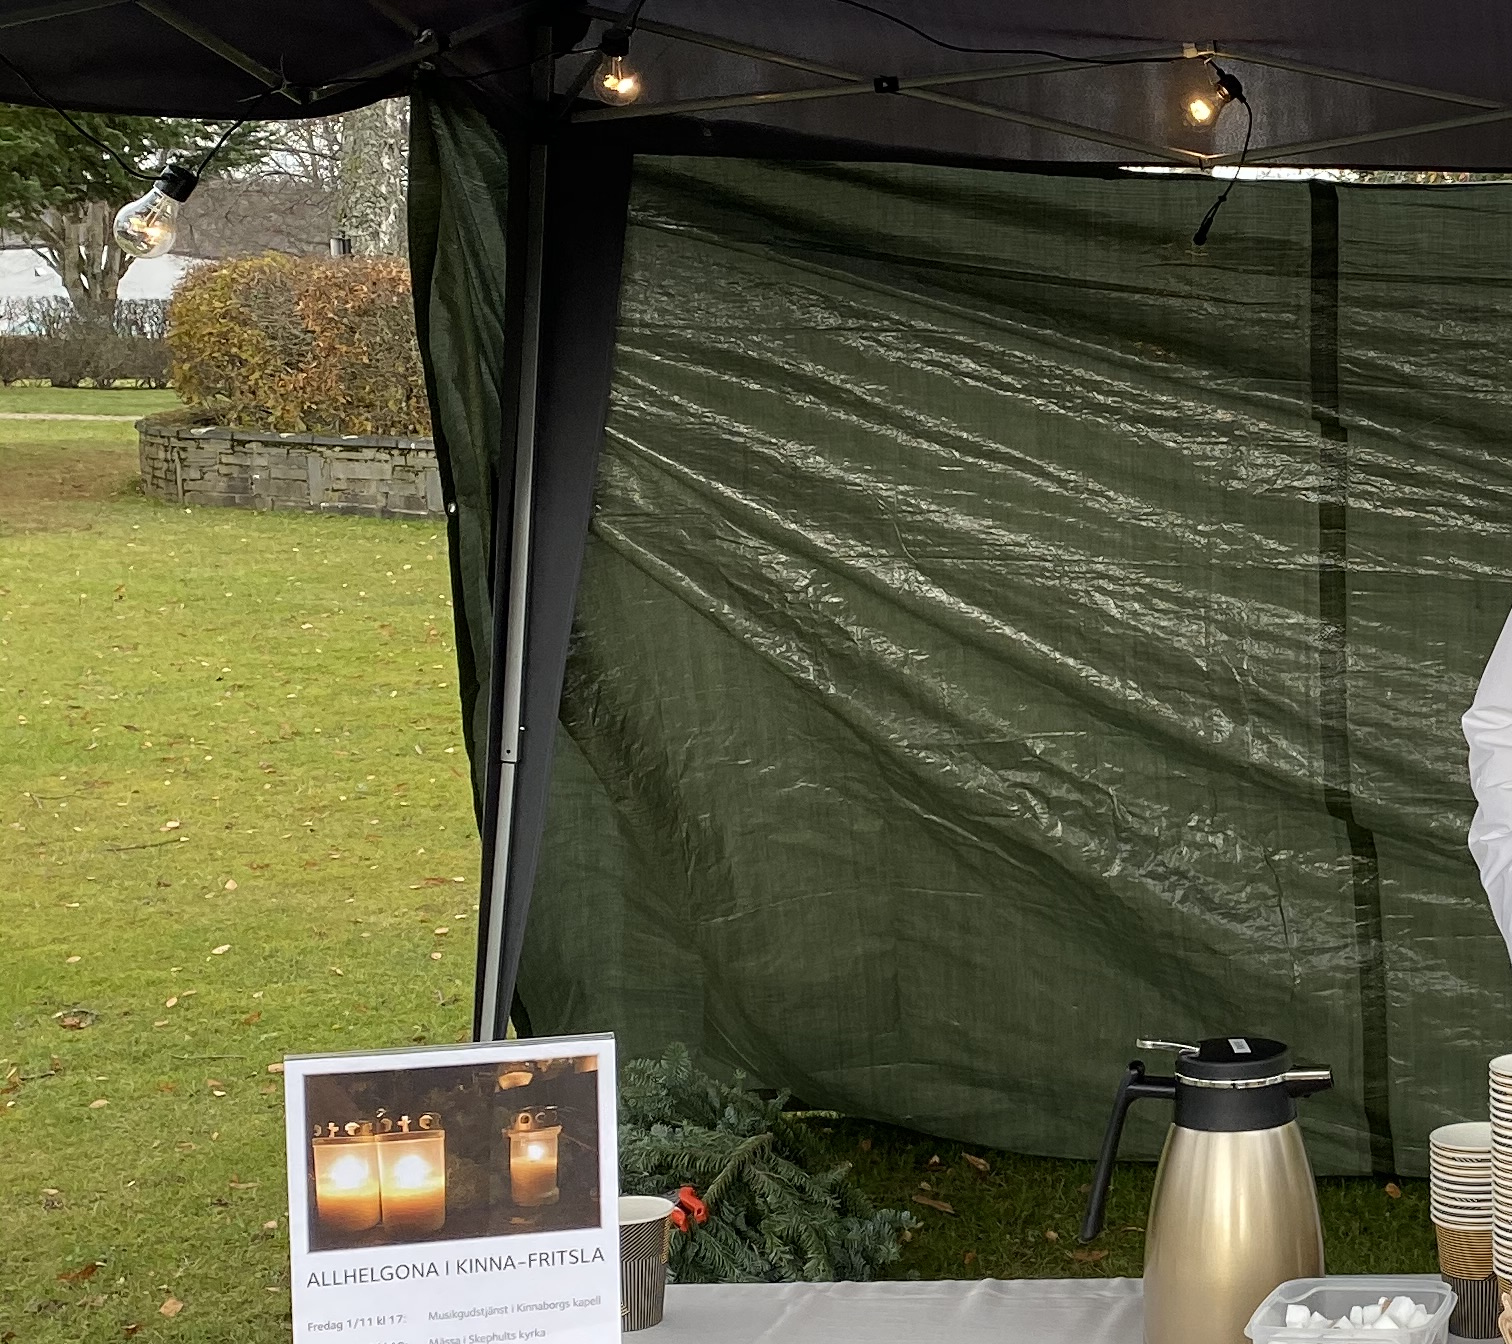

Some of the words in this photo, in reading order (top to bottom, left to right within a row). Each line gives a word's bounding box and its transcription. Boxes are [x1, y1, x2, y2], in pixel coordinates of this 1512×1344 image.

[306, 1261, 440, 1288] ALLHELGONA
[445, 1260, 449, 1276] I
[456, 1247, 605, 1275] KINNA-FRITSLA
[428, 1305, 508, 1321] Musikgudstjänst
[516, 1300, 571, 1312] Kinnaborgs
[572, 1295, 601, 1308] kapell
[307, 1320, 343, 1332] Fredag
[346, 1317, 373, 1329] 1/11
[376, 1315, 386, 1325] kl
[468, 1331, 517, 1344] Skephults
[518, 1328, 546, 1341] kyrka
